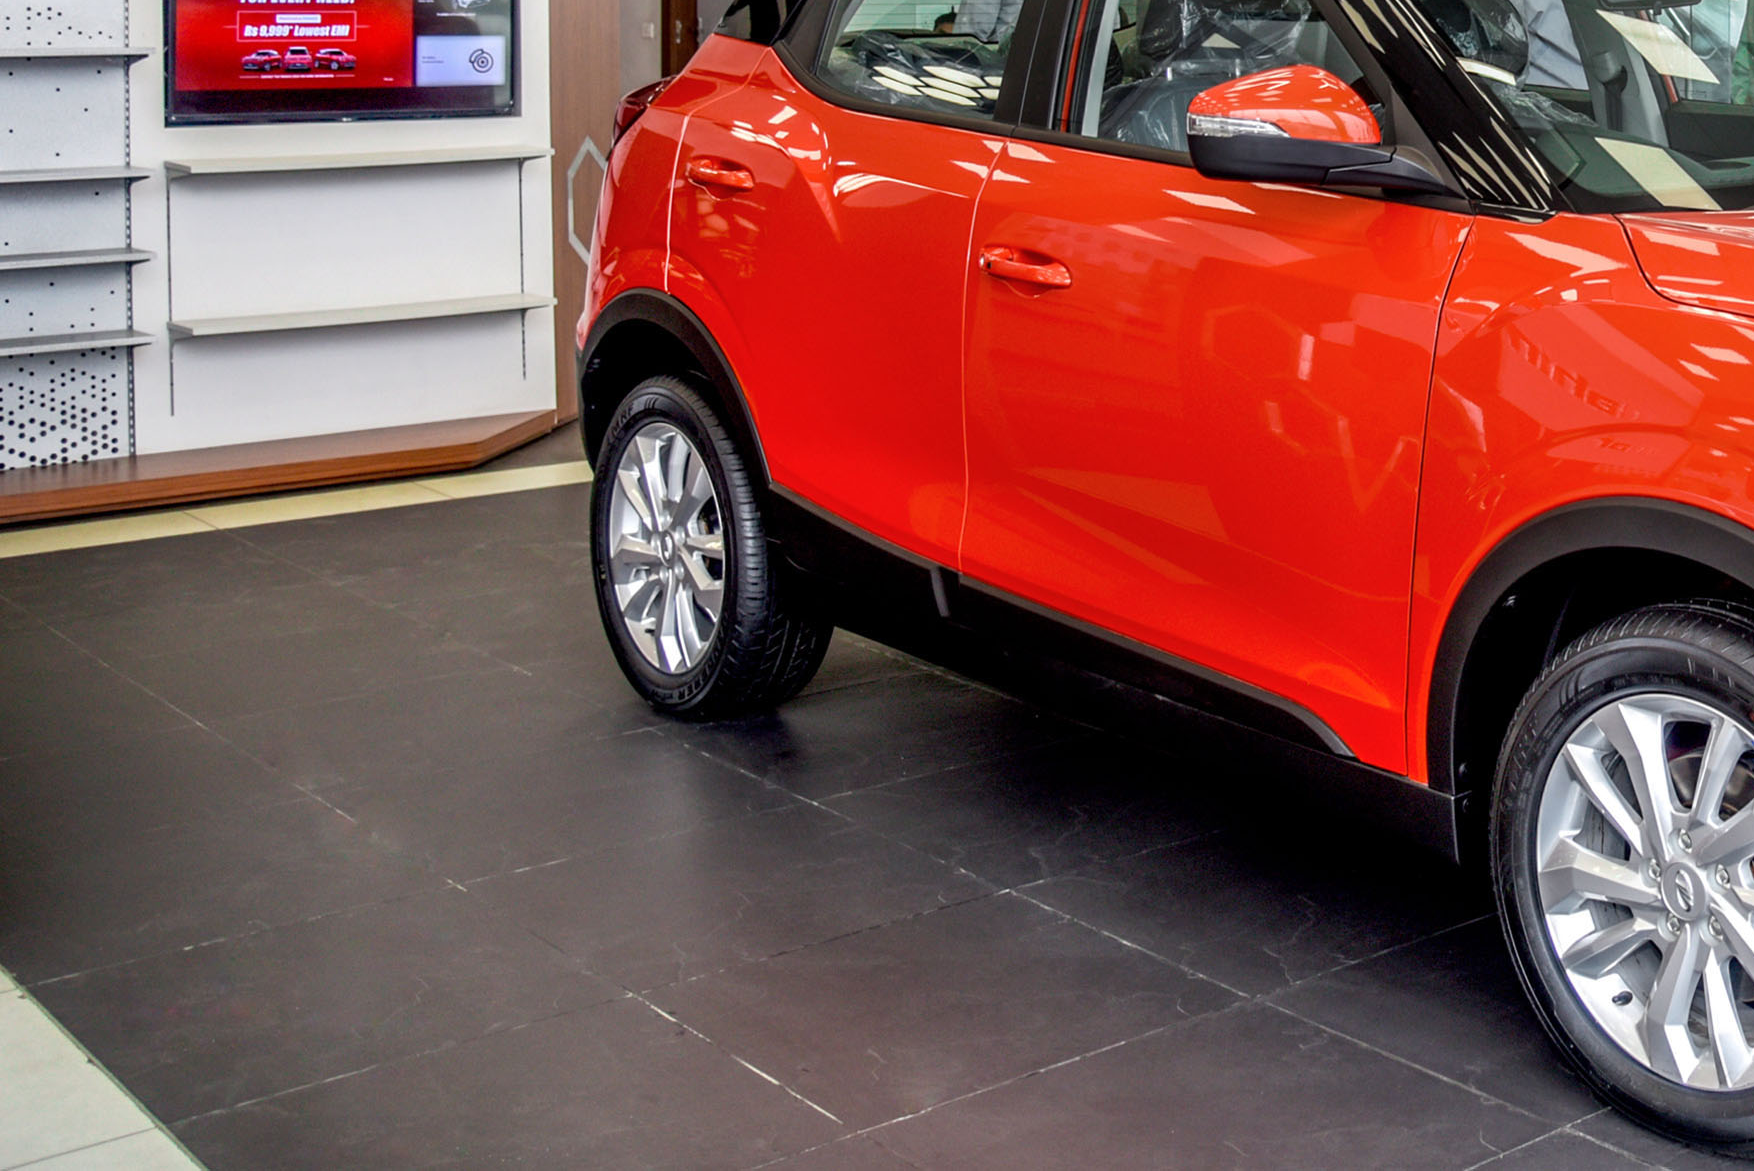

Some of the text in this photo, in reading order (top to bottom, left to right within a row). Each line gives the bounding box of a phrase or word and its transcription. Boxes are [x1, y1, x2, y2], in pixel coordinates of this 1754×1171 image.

[243, 25, 258, 37] Rs
[293, 25, 330, 37] Lowest
[330, 25, 351, 37] EMI
